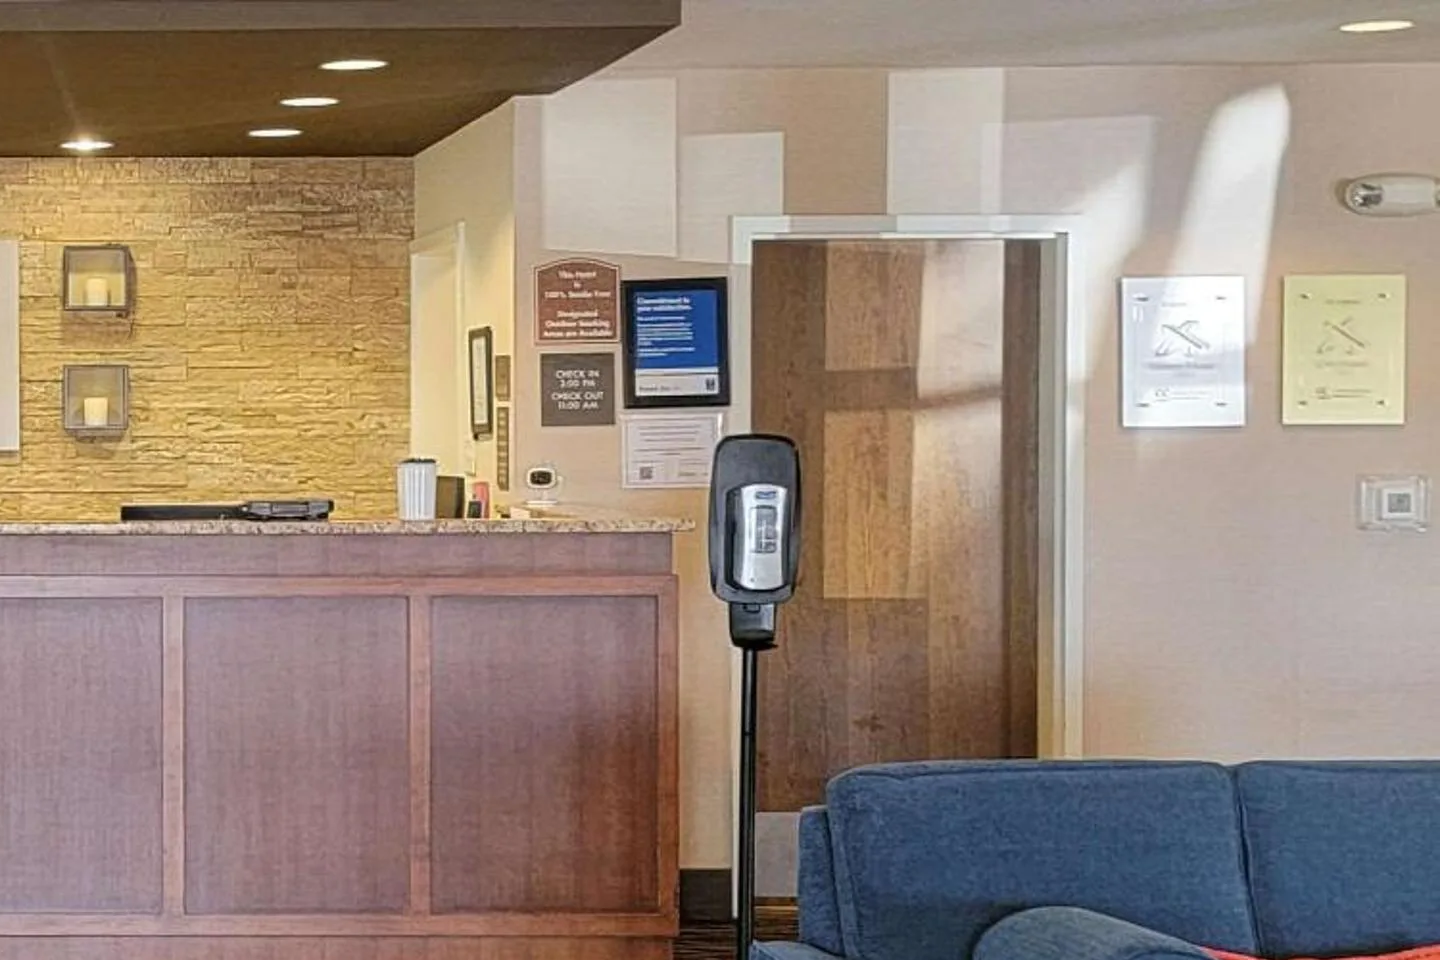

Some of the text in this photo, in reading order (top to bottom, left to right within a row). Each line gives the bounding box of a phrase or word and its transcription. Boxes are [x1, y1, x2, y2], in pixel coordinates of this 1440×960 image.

[557, 310, 598, 319] Designated
[545, 320, 610, 328] Outdoor Smoking
[579, 329, 613, 337] Available
[556, 370, 600, 378] CHECK IN
[583, 379, 597, 387] PM
[551, 391, 604, 400] CHECK OUT
[558, 401, 600, 410] 11:00 AM
